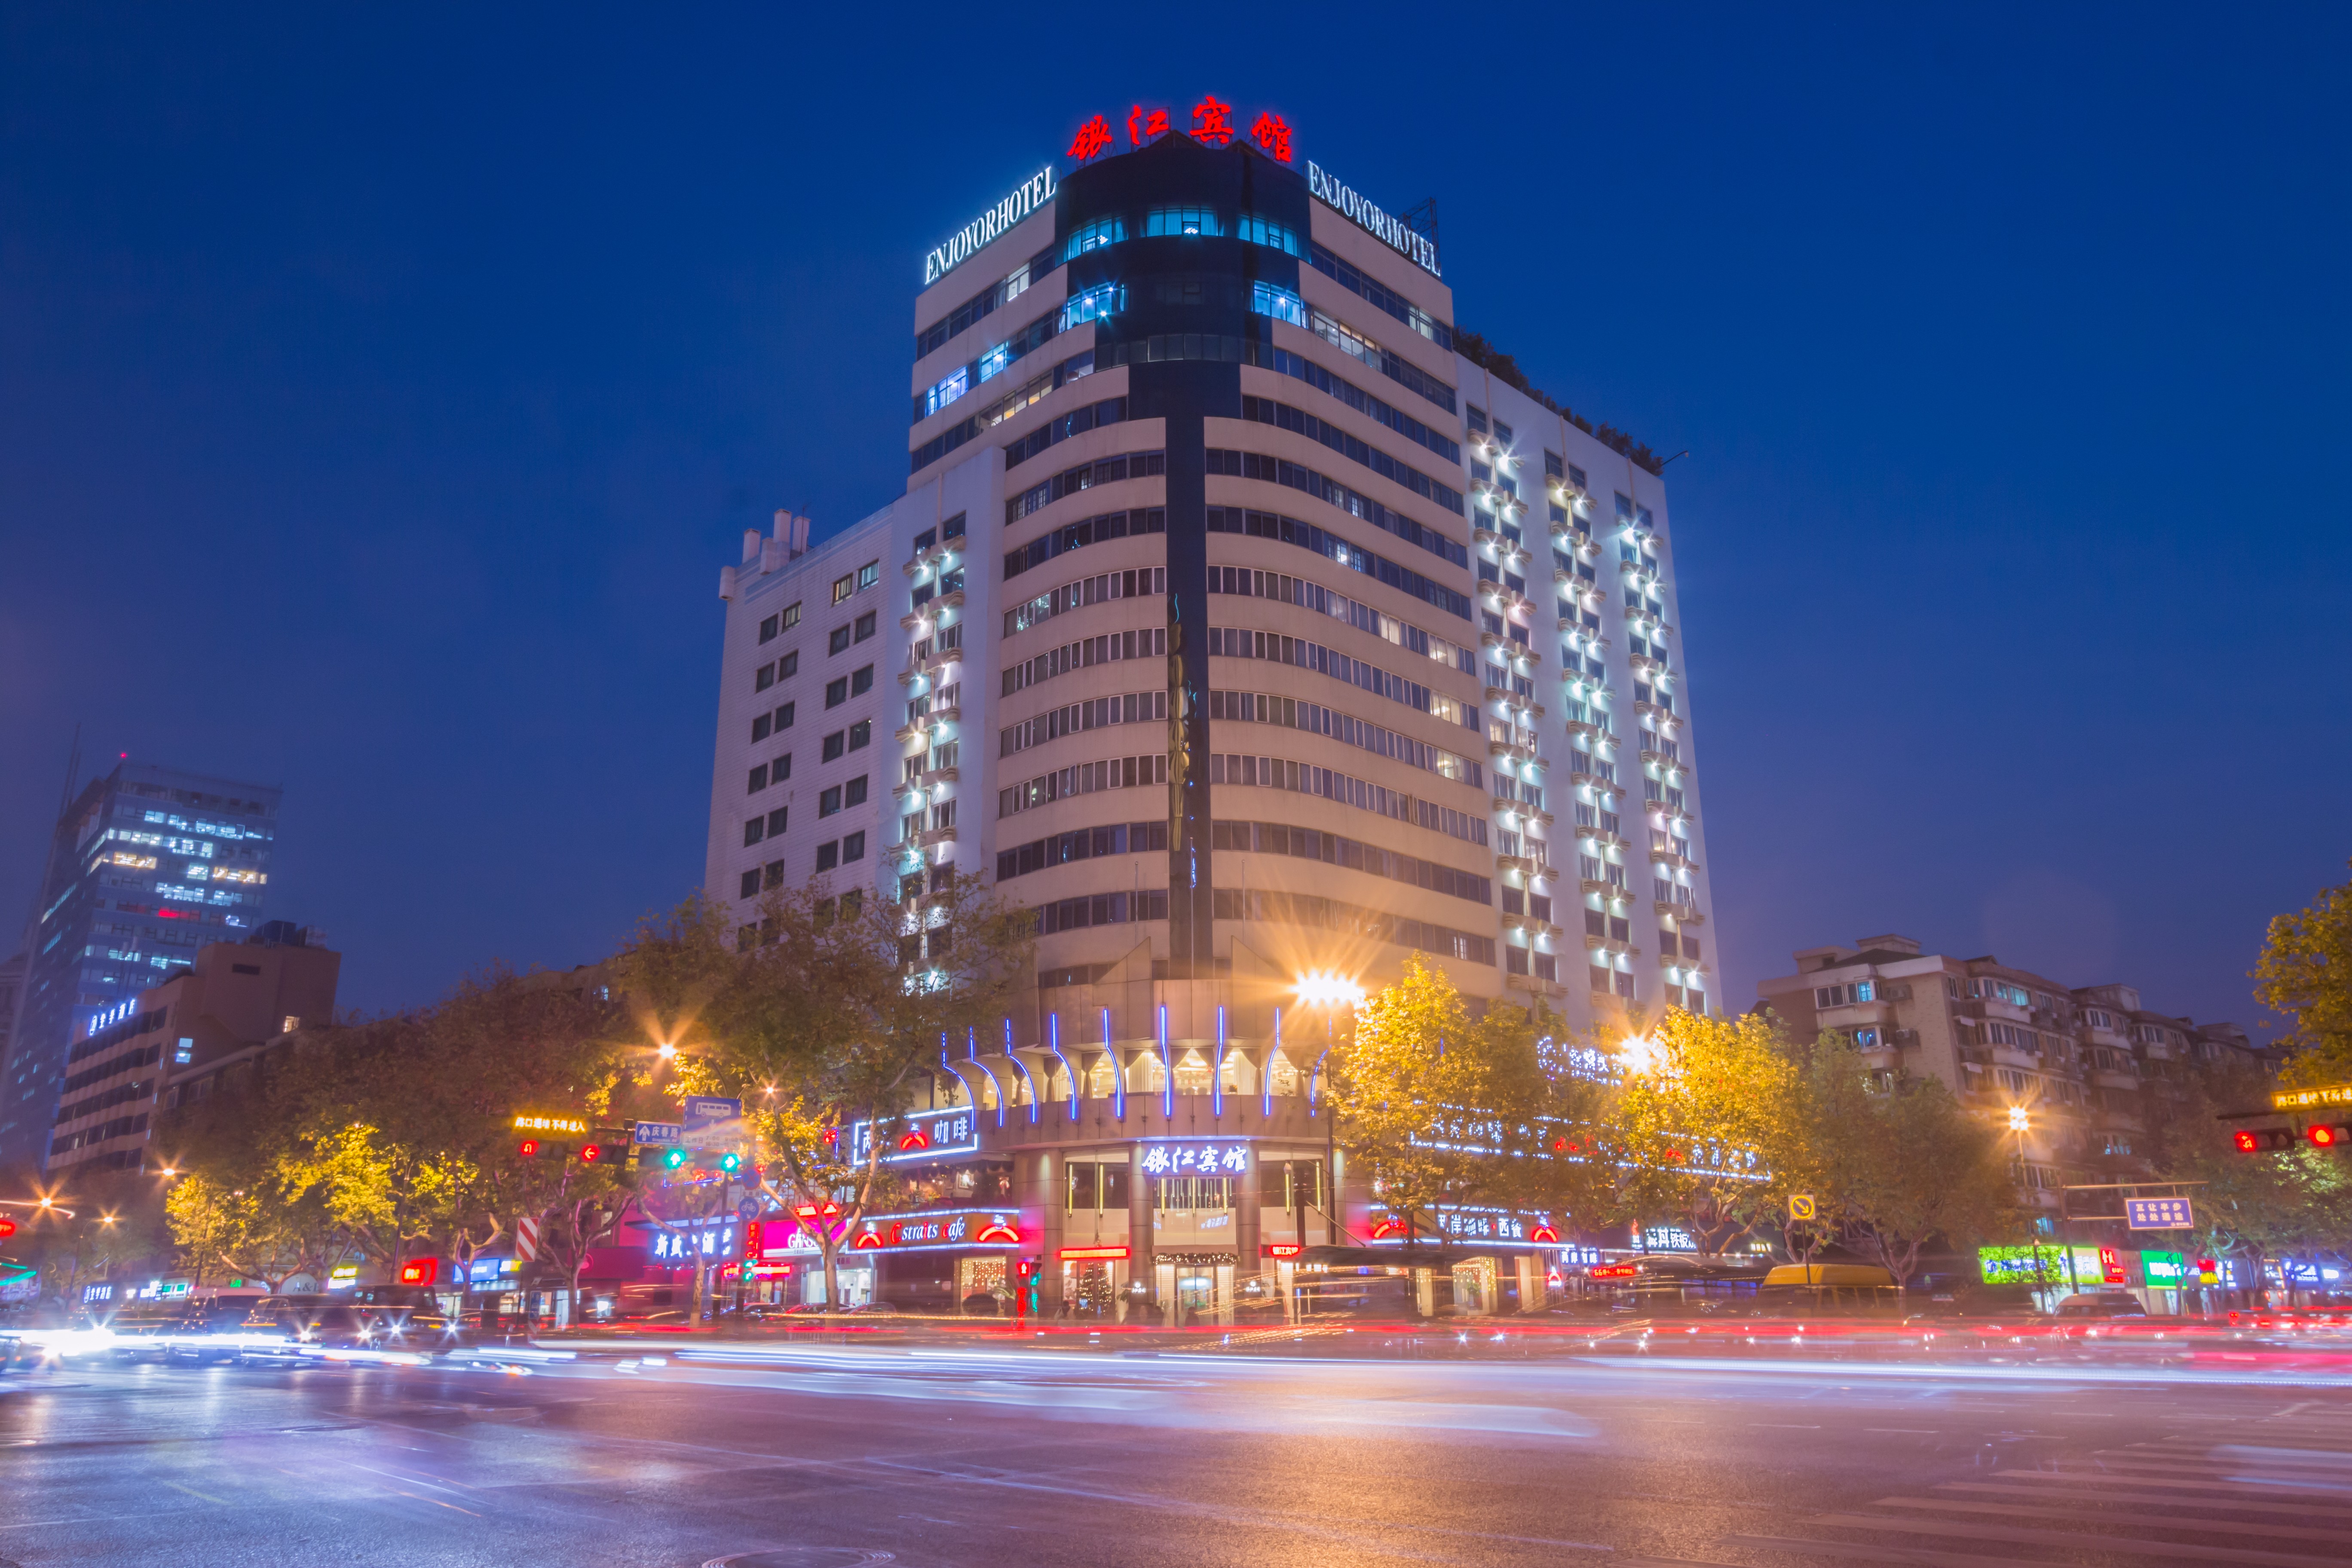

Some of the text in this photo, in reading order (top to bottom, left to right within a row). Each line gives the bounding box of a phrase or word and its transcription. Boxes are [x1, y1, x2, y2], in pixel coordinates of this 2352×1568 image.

[1067, 96, 1292, 162] 银江宾馆
[925, 166, 1056, 285] ENJOYORHOTEL
[1308, 160, 1441, 277] ENJOYORHOTEL
[652, 1126, 678, 1138] 庆春路
[934, 1116, 968, 1144] 咖啡
[1142, 1146, 1246, 1173] 银江宾馆
[2136, 1202, 2181, 1212] 互让半步
